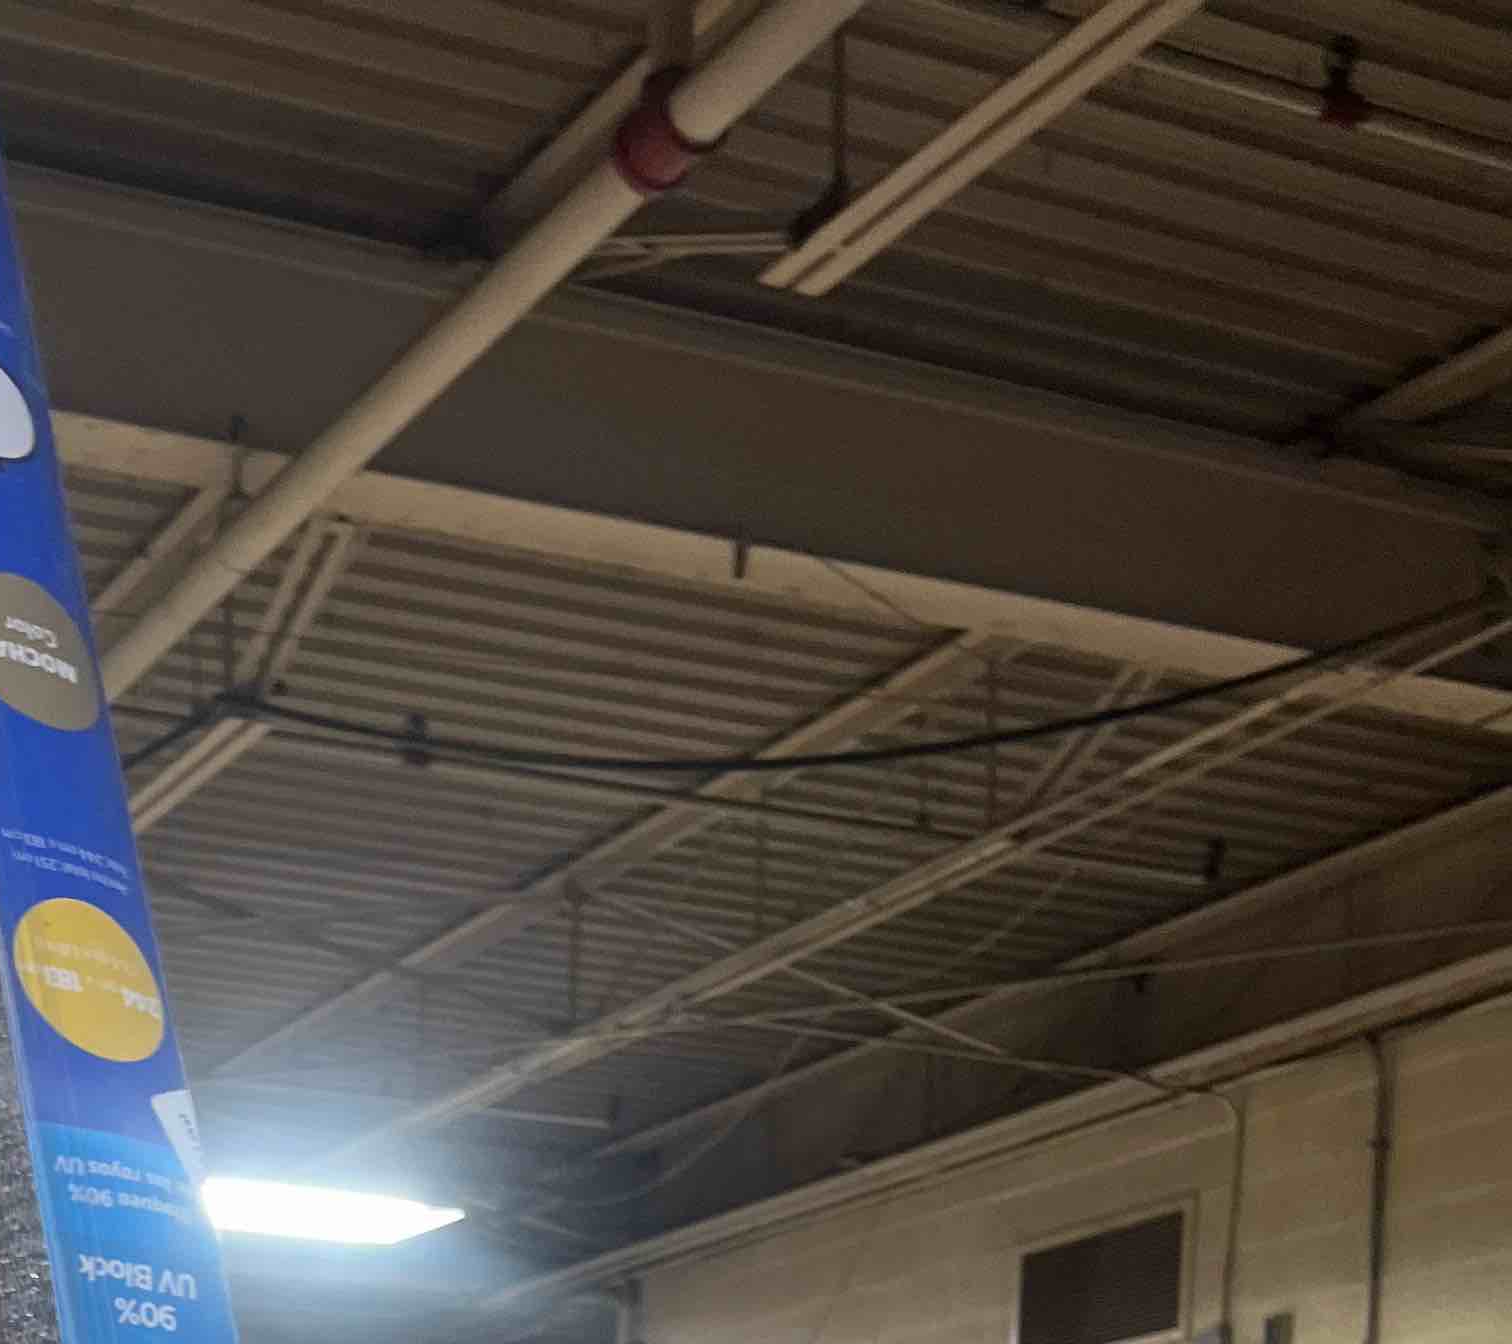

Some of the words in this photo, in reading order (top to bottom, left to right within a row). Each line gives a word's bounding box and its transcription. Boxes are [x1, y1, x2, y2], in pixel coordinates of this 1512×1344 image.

[78, 1253, 153, 1292] Block
[158, 1269, 198, 1299] UV
[114, 1297, 177, 1331] 90%
